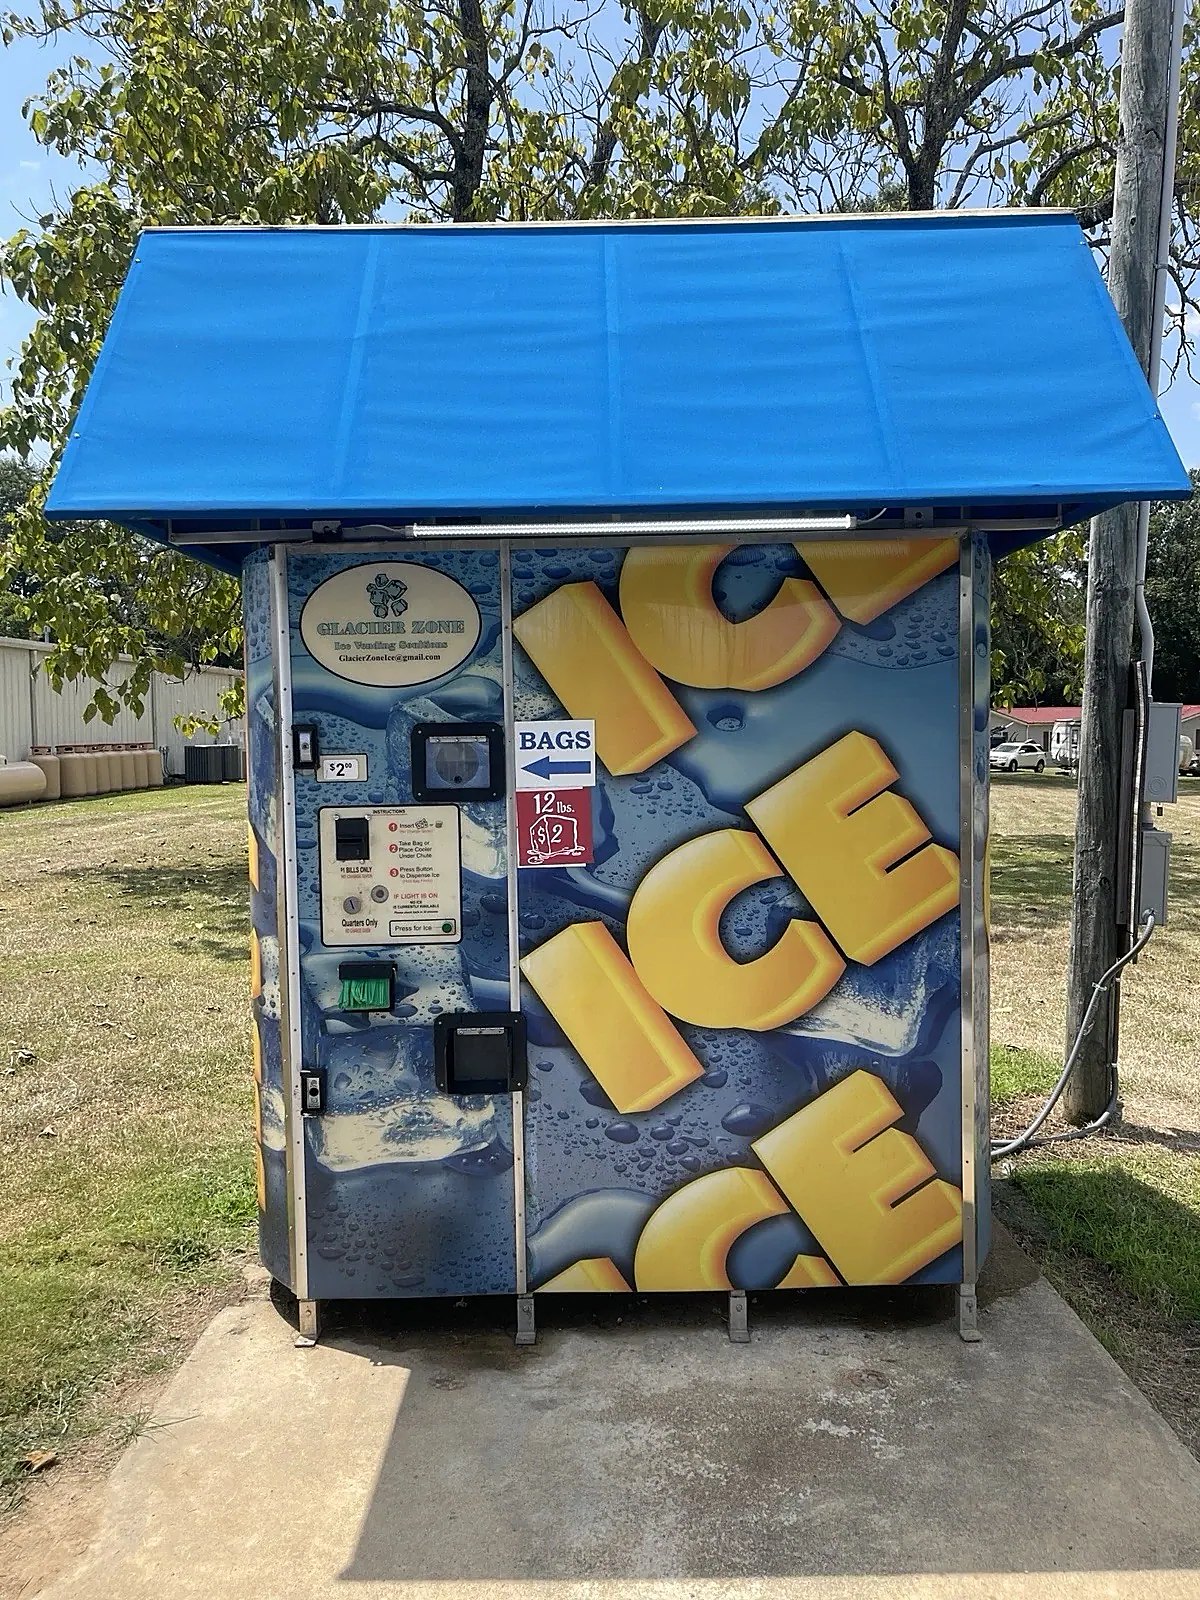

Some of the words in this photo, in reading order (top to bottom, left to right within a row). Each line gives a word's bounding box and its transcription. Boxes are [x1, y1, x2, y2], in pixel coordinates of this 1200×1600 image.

[317, 621, 405, 635] GLACIER
[411, 620, 465, 634] ZONE
[334, 642, 352, 650] Ice
[354, 641, 396, 651] Vending
[339, 654, 441, 662] GlacierZoneIce@gmail.com
[519, 731, 591, 750] BAGS
[533, 792, 556, 814] 12
[557, 801, 575, 813] lbs.
[342, 919, 364, 927] Quarters
[366, 918, 378, 928] Only
[519, 730, 960, 1114] ICE
[535, 1070, 963, 1292] CE
